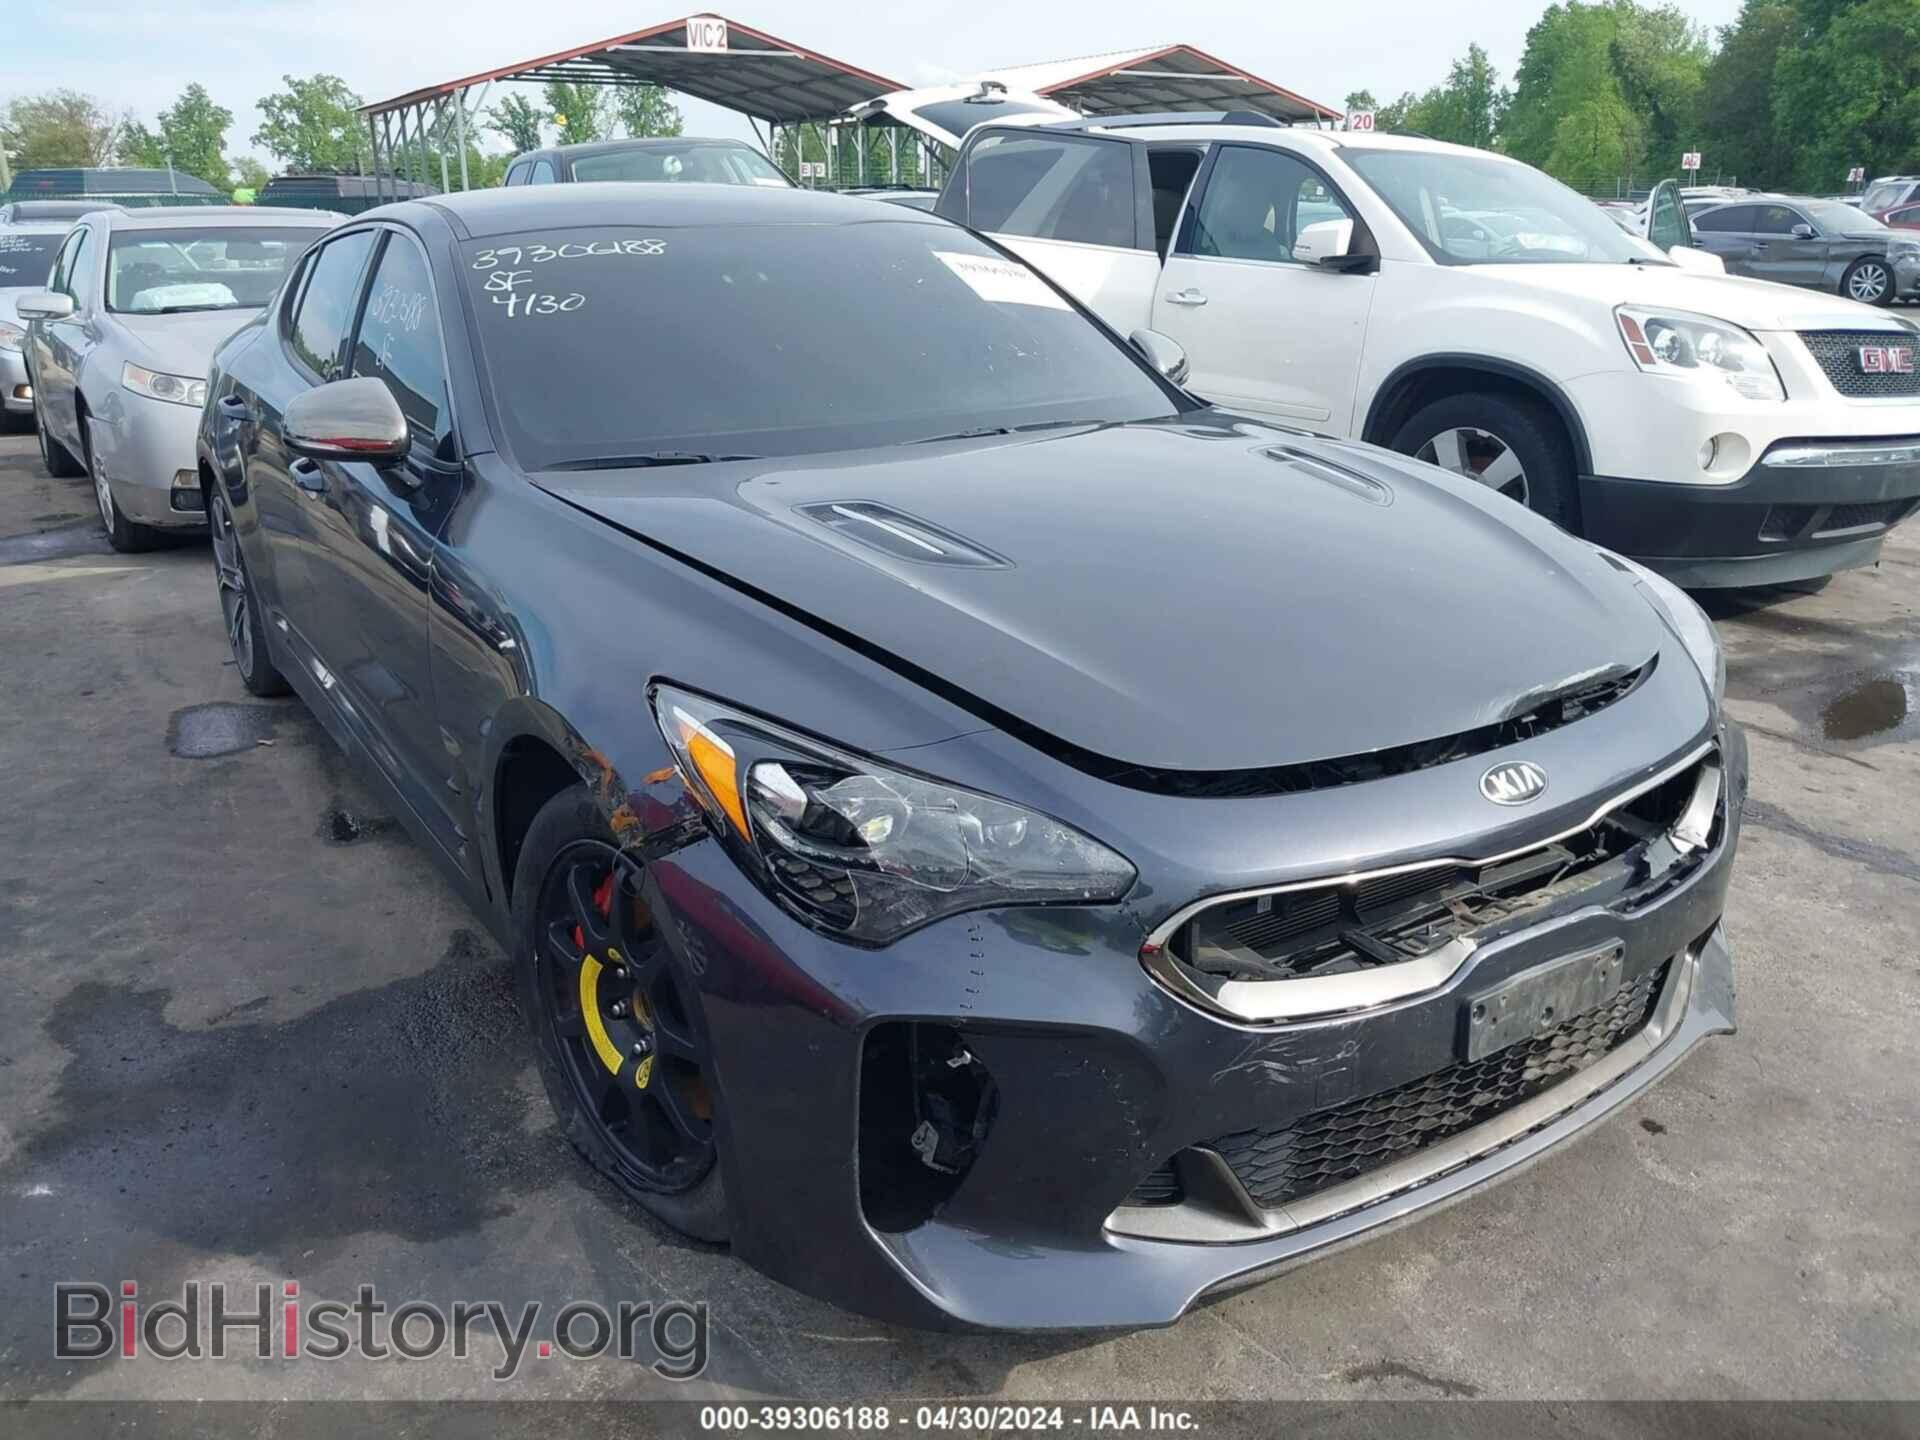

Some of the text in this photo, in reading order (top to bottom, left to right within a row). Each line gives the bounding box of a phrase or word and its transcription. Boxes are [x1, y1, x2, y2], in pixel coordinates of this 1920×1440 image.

[689, 23, 726, 48] VIC 2
[1353, 114, 1373, 130] 20
[484, 270, 533, 292] SF
[1861, 347, 1914, 373] GMC
[1487, 764, 1545, 796] KIA
